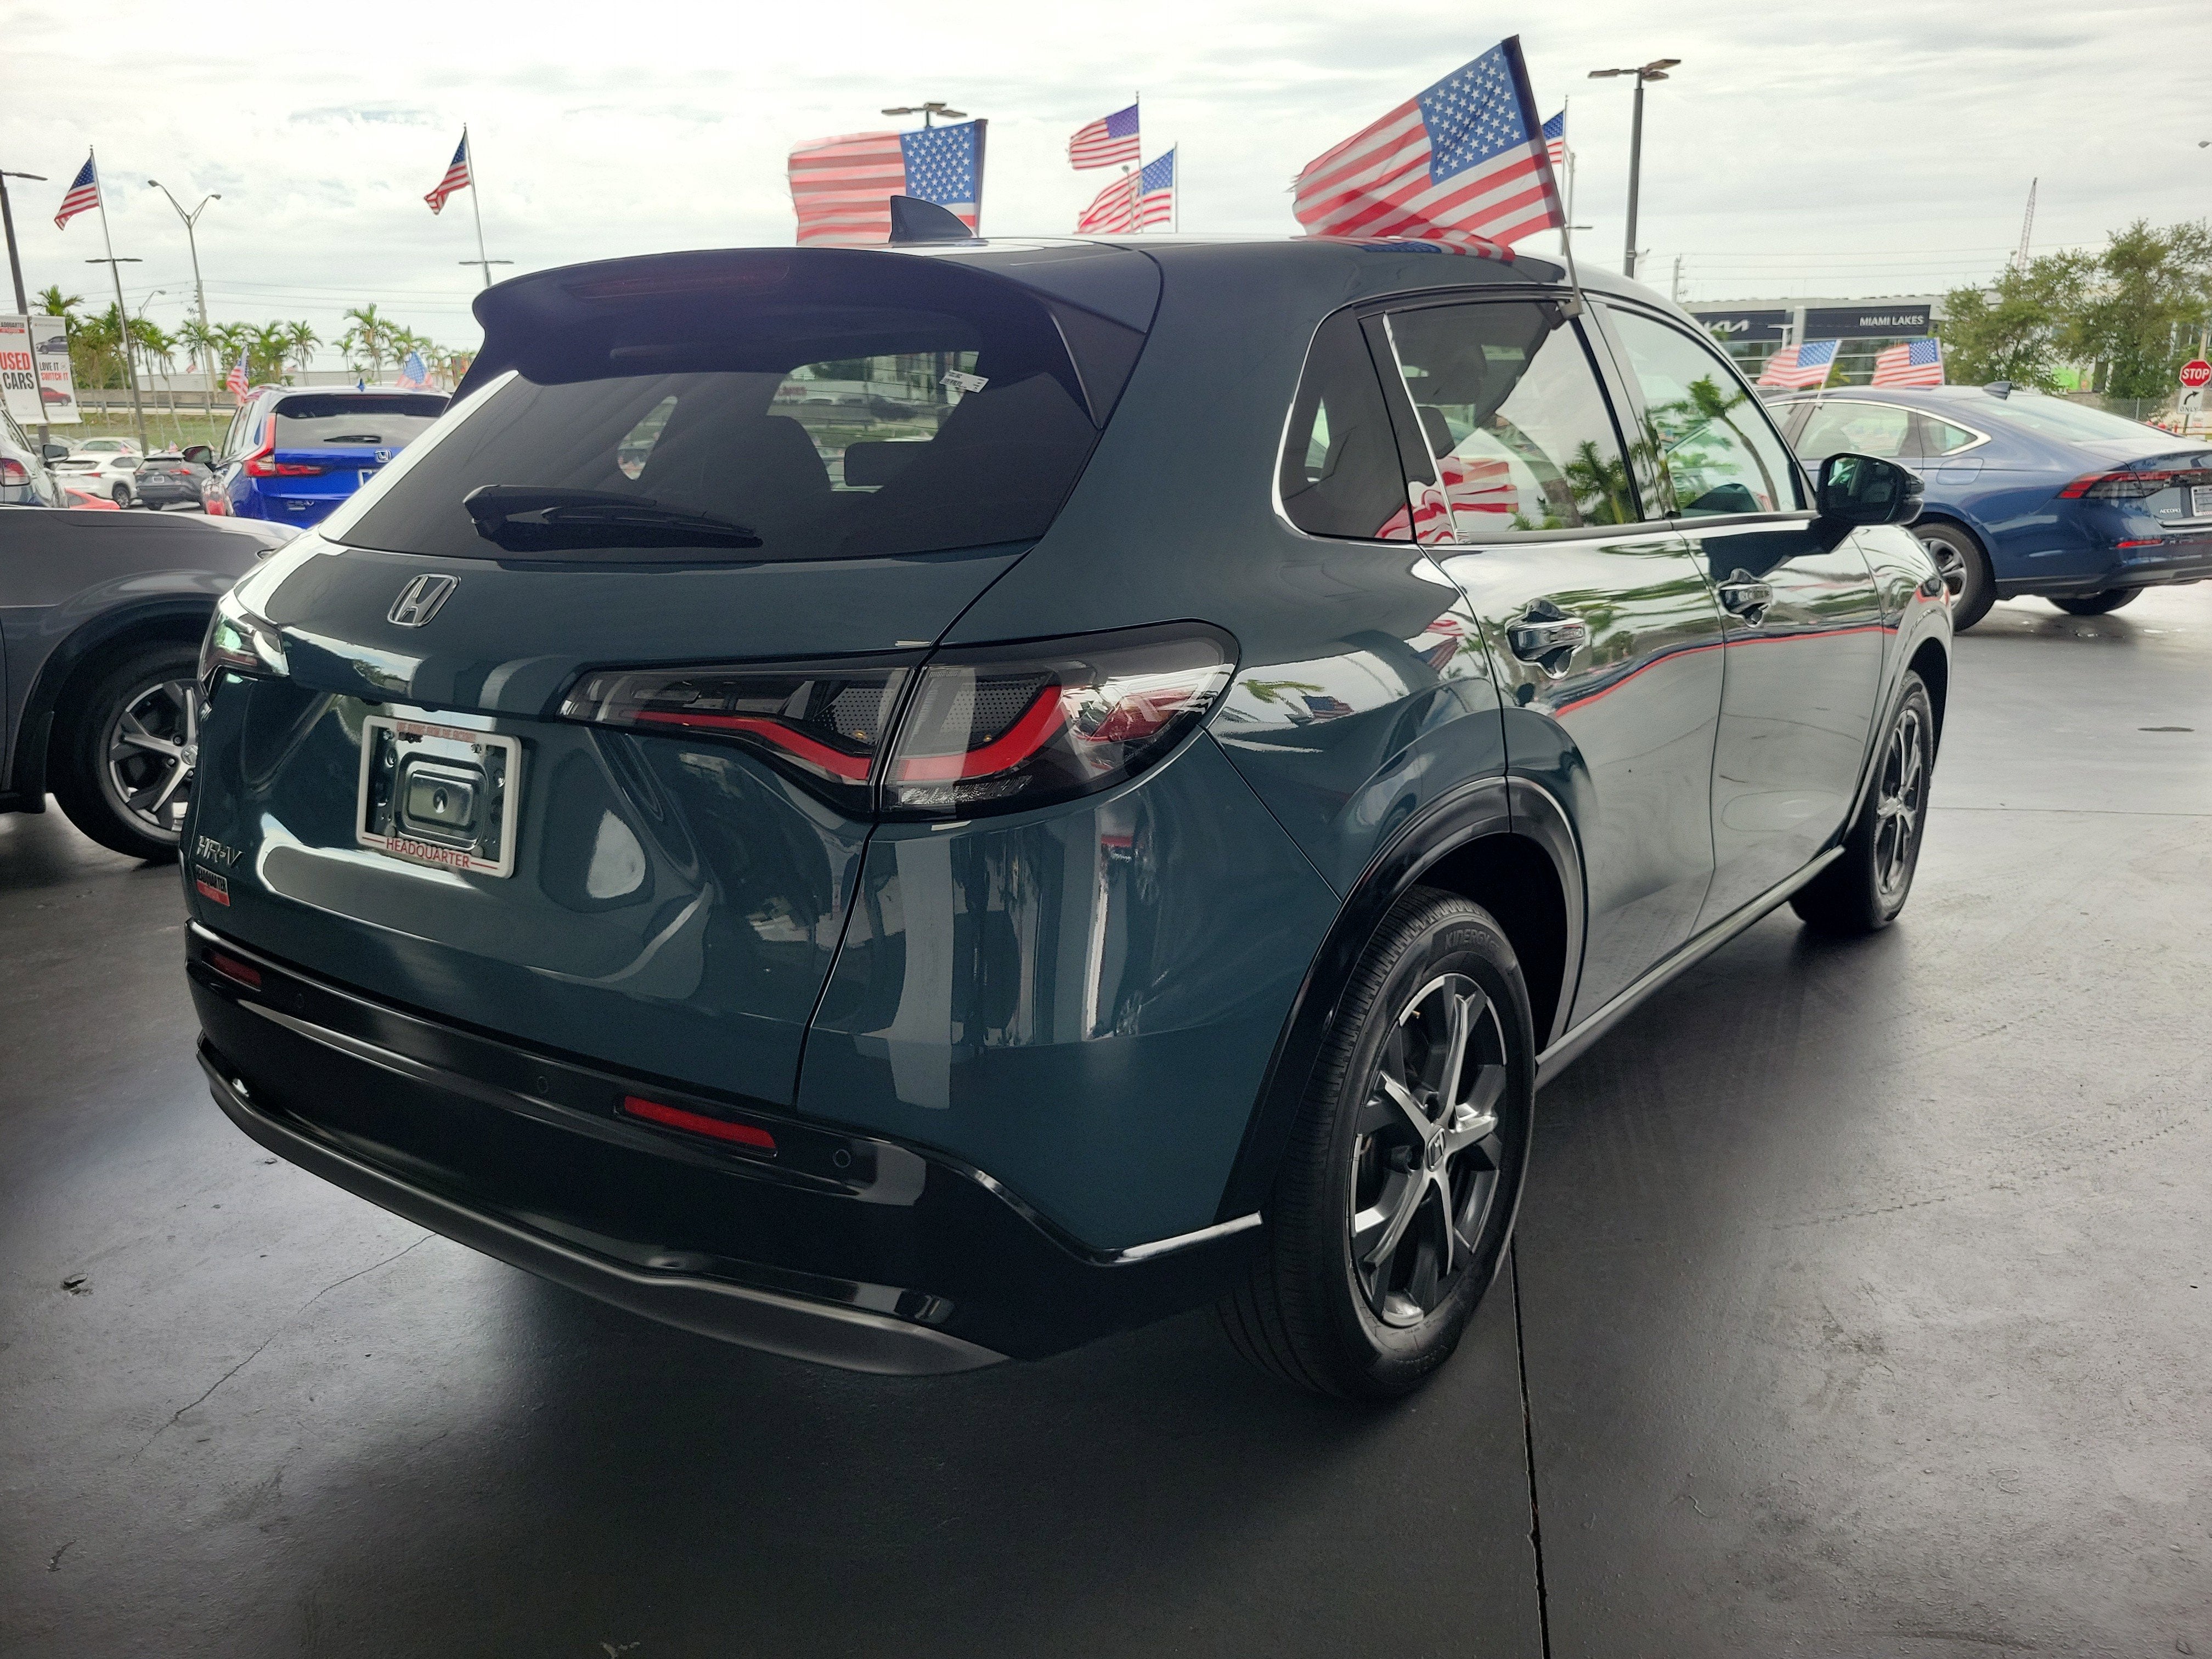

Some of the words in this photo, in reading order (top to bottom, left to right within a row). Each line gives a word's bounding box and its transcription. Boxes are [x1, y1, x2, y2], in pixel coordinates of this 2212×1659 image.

[1859, 317, 1890, 326] MIAMI
[1892, 315, 1924, 325] LAKES
[0, 352, 31, 370] USED
[40, 362, 52, 371] LOVE
[53, 362, 59, 370] IT
[3, 372, 35, 390] CARS
[41, 372, 62, 381] SWITCH
[63, 372, 69, 381] IT
[2182, 368, 2210, 380] STOP
[196, 835, 242, 865] HR-V
[386, 840, 470, 868] HEADQUARTER
